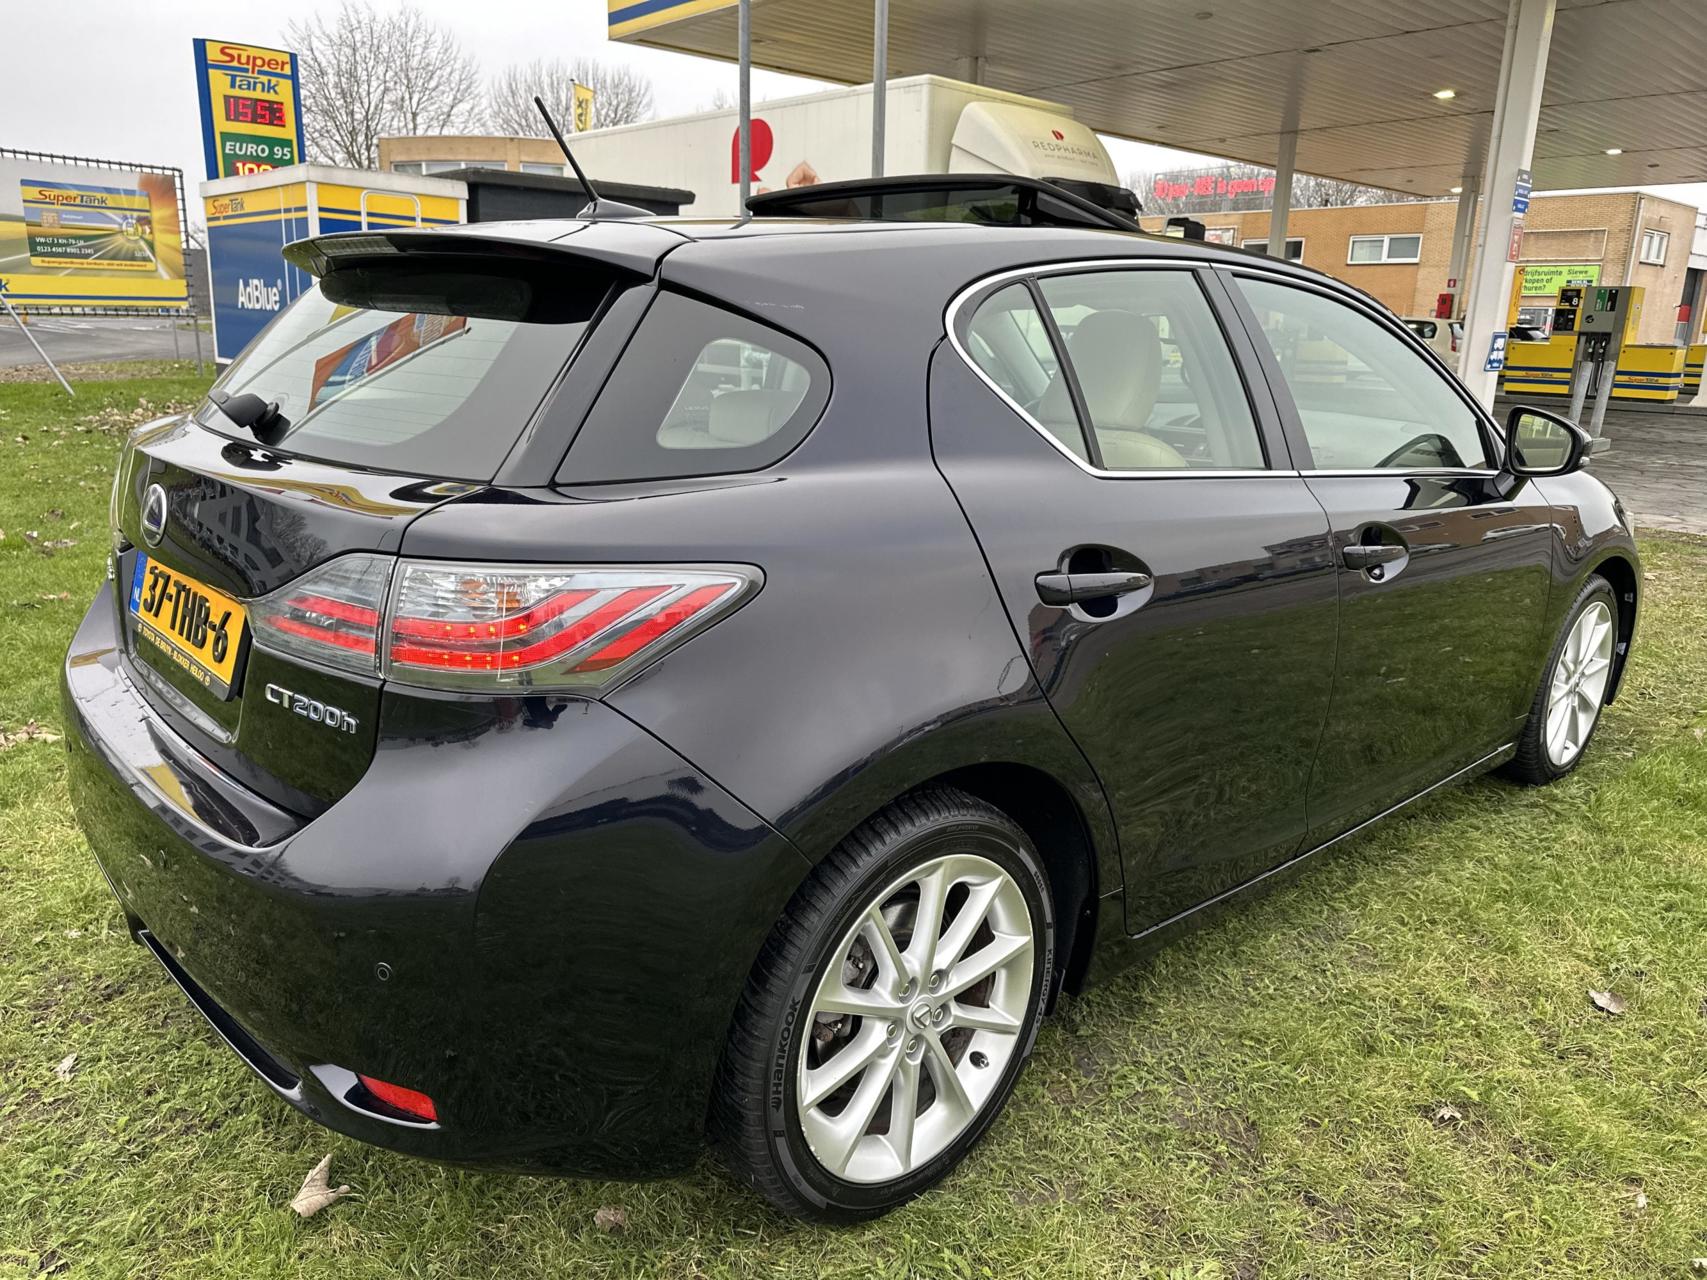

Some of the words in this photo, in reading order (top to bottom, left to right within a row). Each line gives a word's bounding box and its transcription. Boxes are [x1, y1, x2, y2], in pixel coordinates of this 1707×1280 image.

[208, 46, 289, 74] Super
[222, 73, 279, 95] Tank
[229, 98, 286, 125] 1553
[225, 141, 269, 157] EURO
[273, 146, 291, 160] 95
[1031, 141, 1098, 160] REDPHARMA
[33, 189, 108, 206] SuperTank
[1524, 269, 1563, 277] drijfsruimte
[1572, 297, 1579, 306] 8
[143, 565, 233, 663] 37-THB-6
